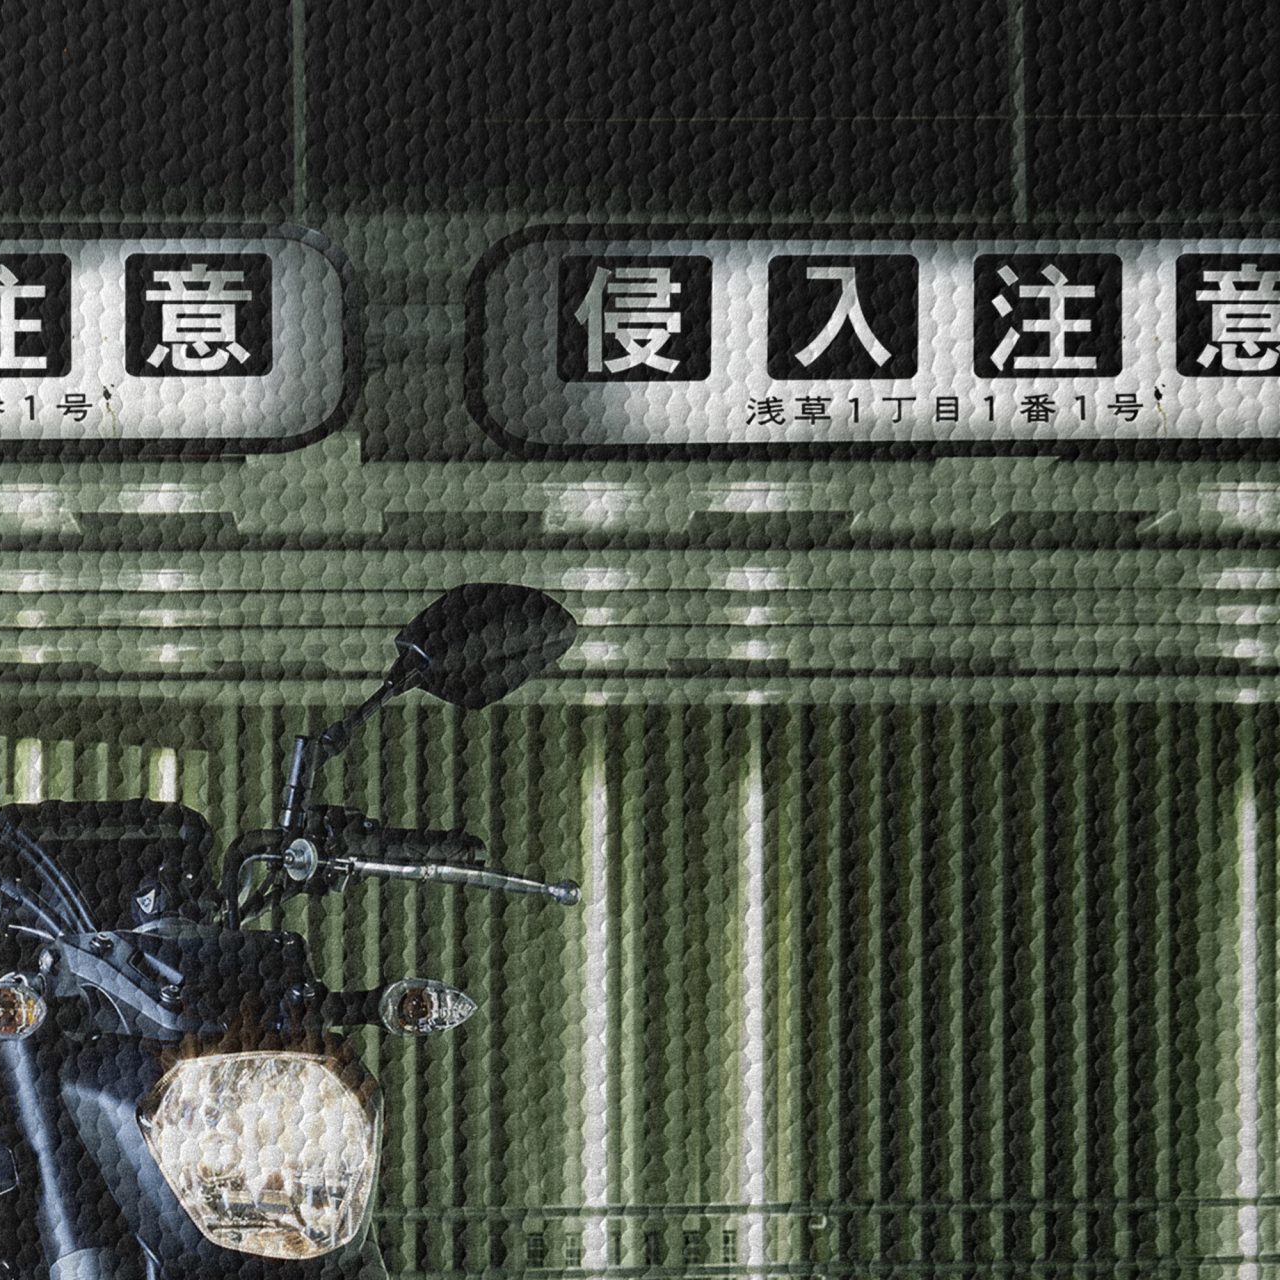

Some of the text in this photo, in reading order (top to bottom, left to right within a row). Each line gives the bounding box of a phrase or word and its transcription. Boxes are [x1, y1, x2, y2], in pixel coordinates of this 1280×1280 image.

[746, 395, 1144, 426] 浅草1丁目1番1号
